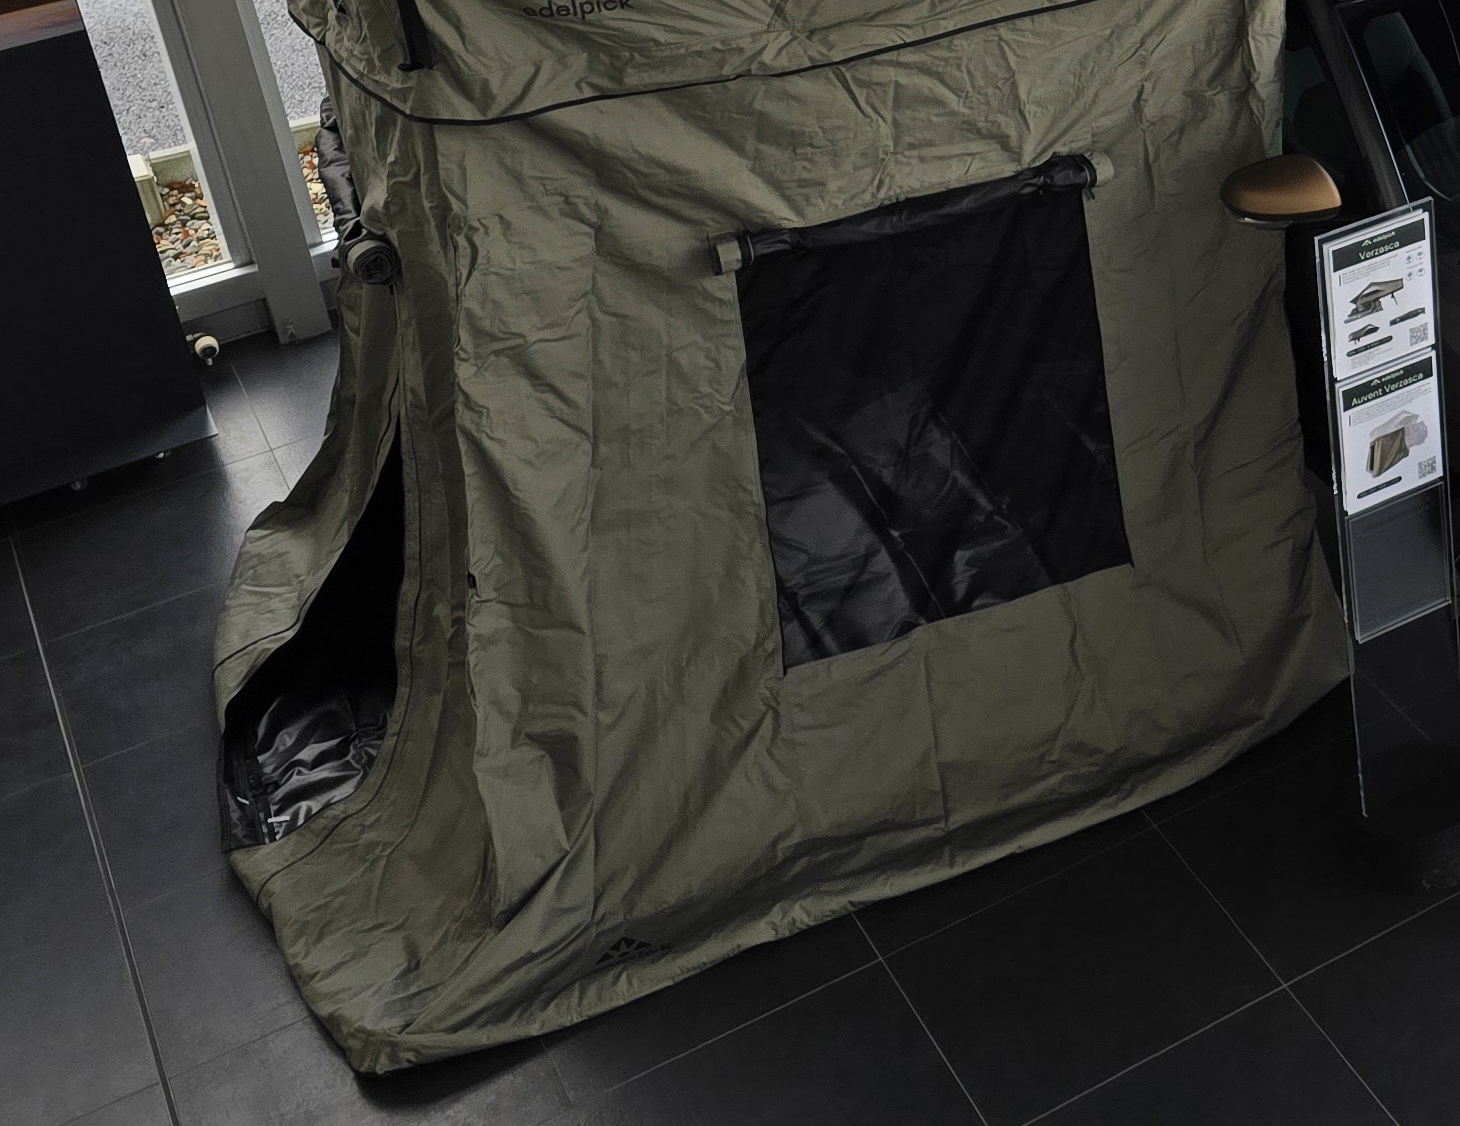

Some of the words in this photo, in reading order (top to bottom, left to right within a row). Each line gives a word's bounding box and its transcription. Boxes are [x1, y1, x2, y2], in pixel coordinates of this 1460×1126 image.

[1359, 240, 1400, 260] Verzasca
[1351, 388, 1383, 407] Auvent
[1383, 372, 1424, 393] Verzasca
